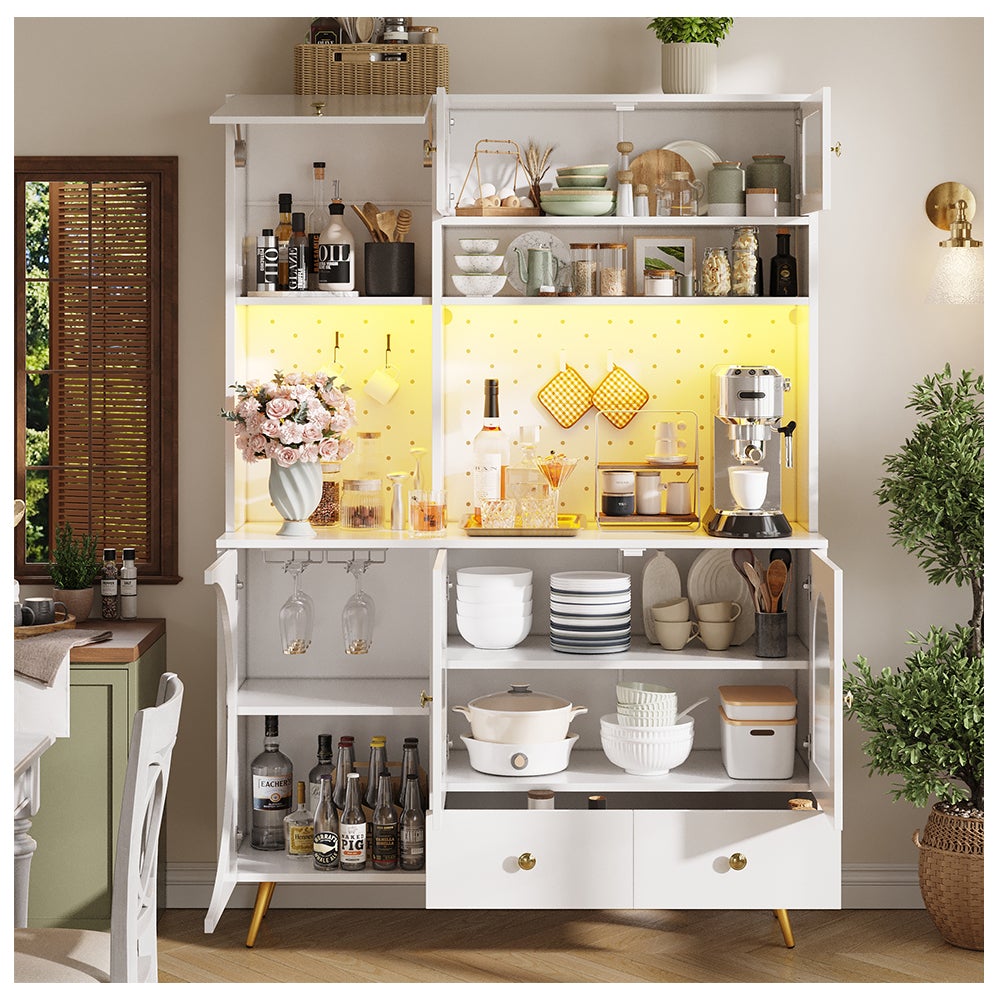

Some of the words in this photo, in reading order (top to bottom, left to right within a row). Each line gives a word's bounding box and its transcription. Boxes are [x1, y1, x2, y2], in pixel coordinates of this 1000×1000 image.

[264, 248, 279, 285] OIL
[318, 244, 351, 262] OIL
[289, 247, 298, 290] GLAZE
[341, 839, 364, 851] PIG
